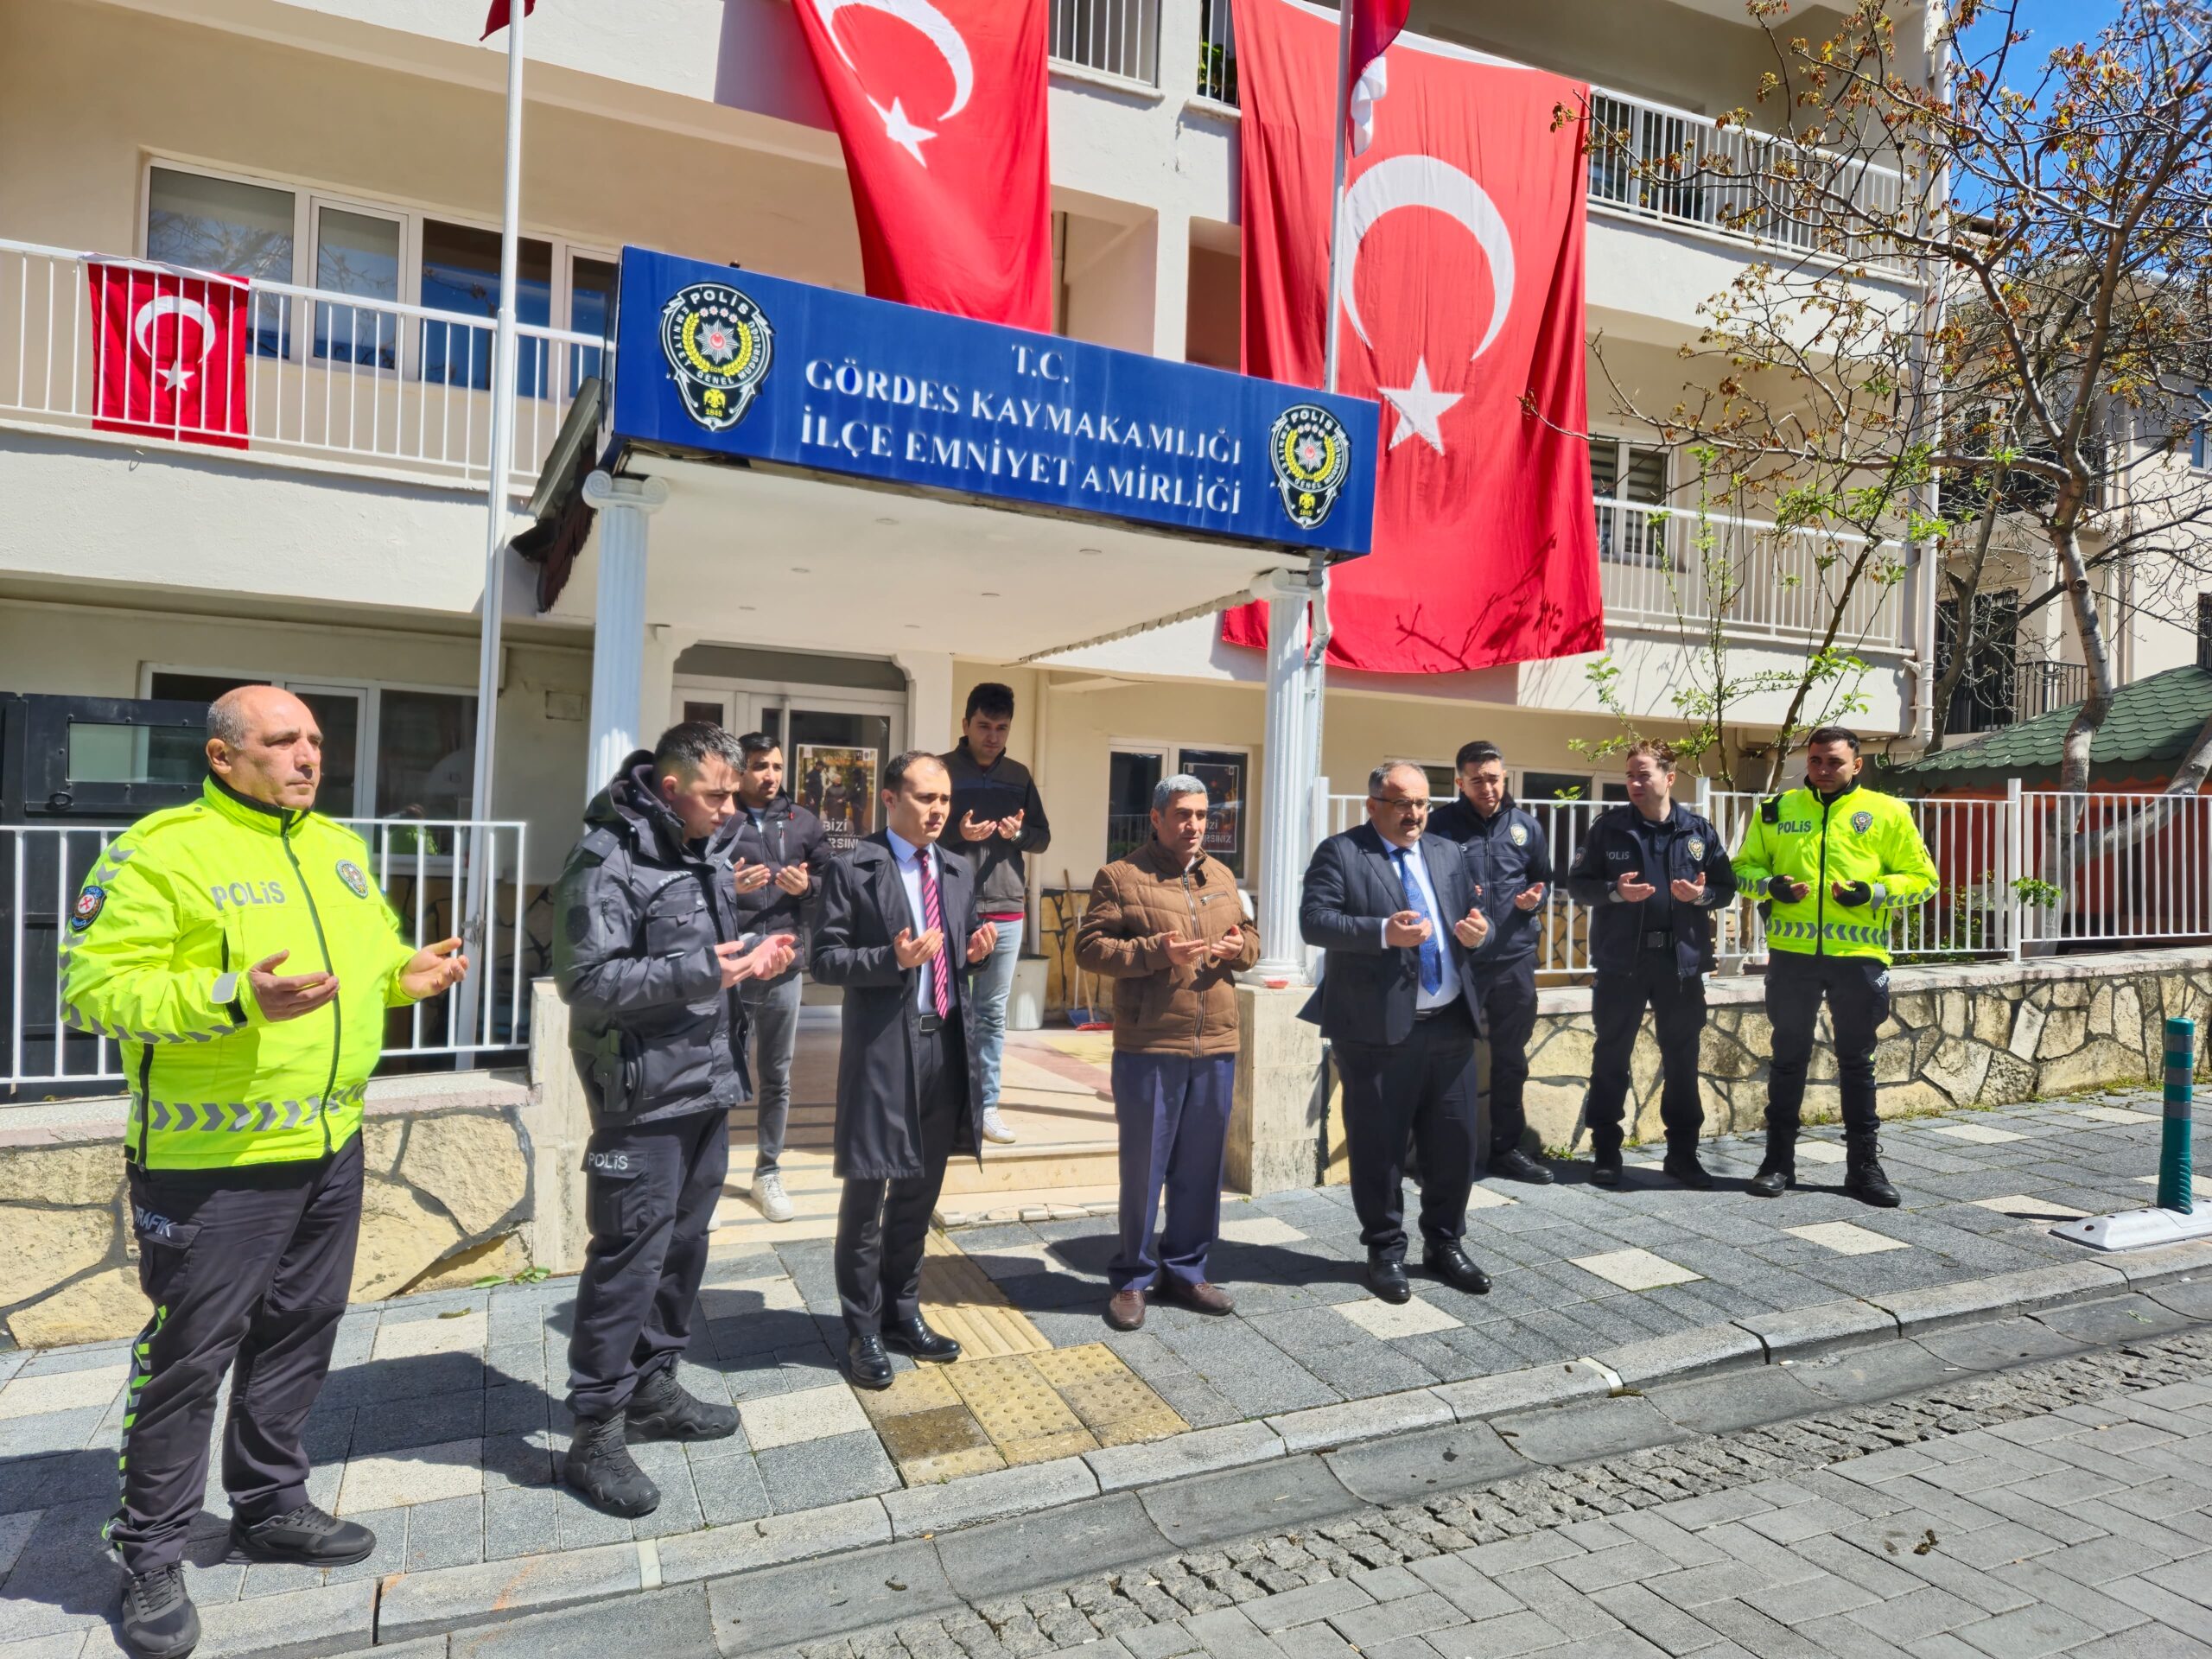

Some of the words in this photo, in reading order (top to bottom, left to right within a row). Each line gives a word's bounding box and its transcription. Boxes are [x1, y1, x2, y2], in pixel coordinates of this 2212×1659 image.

[690, 289, 749, 315] POLİS
[1012, 344, 1071, 383] T.C.
[696, 370, 734, 385] GENEL
[705, 408, 723, 417] 1845
[805, 357, 959, 414] GÖRDES
[971, 390, 1241, 464] KAYMAKAMLIĞI
[1291, 410, 1333, 429] POLİS
[801, 404, 893, 458] İLÇE
[906, 432, 1075, 486] EMNİYET
[1081, 463, 1241, 514] AMİRLİĞİ
